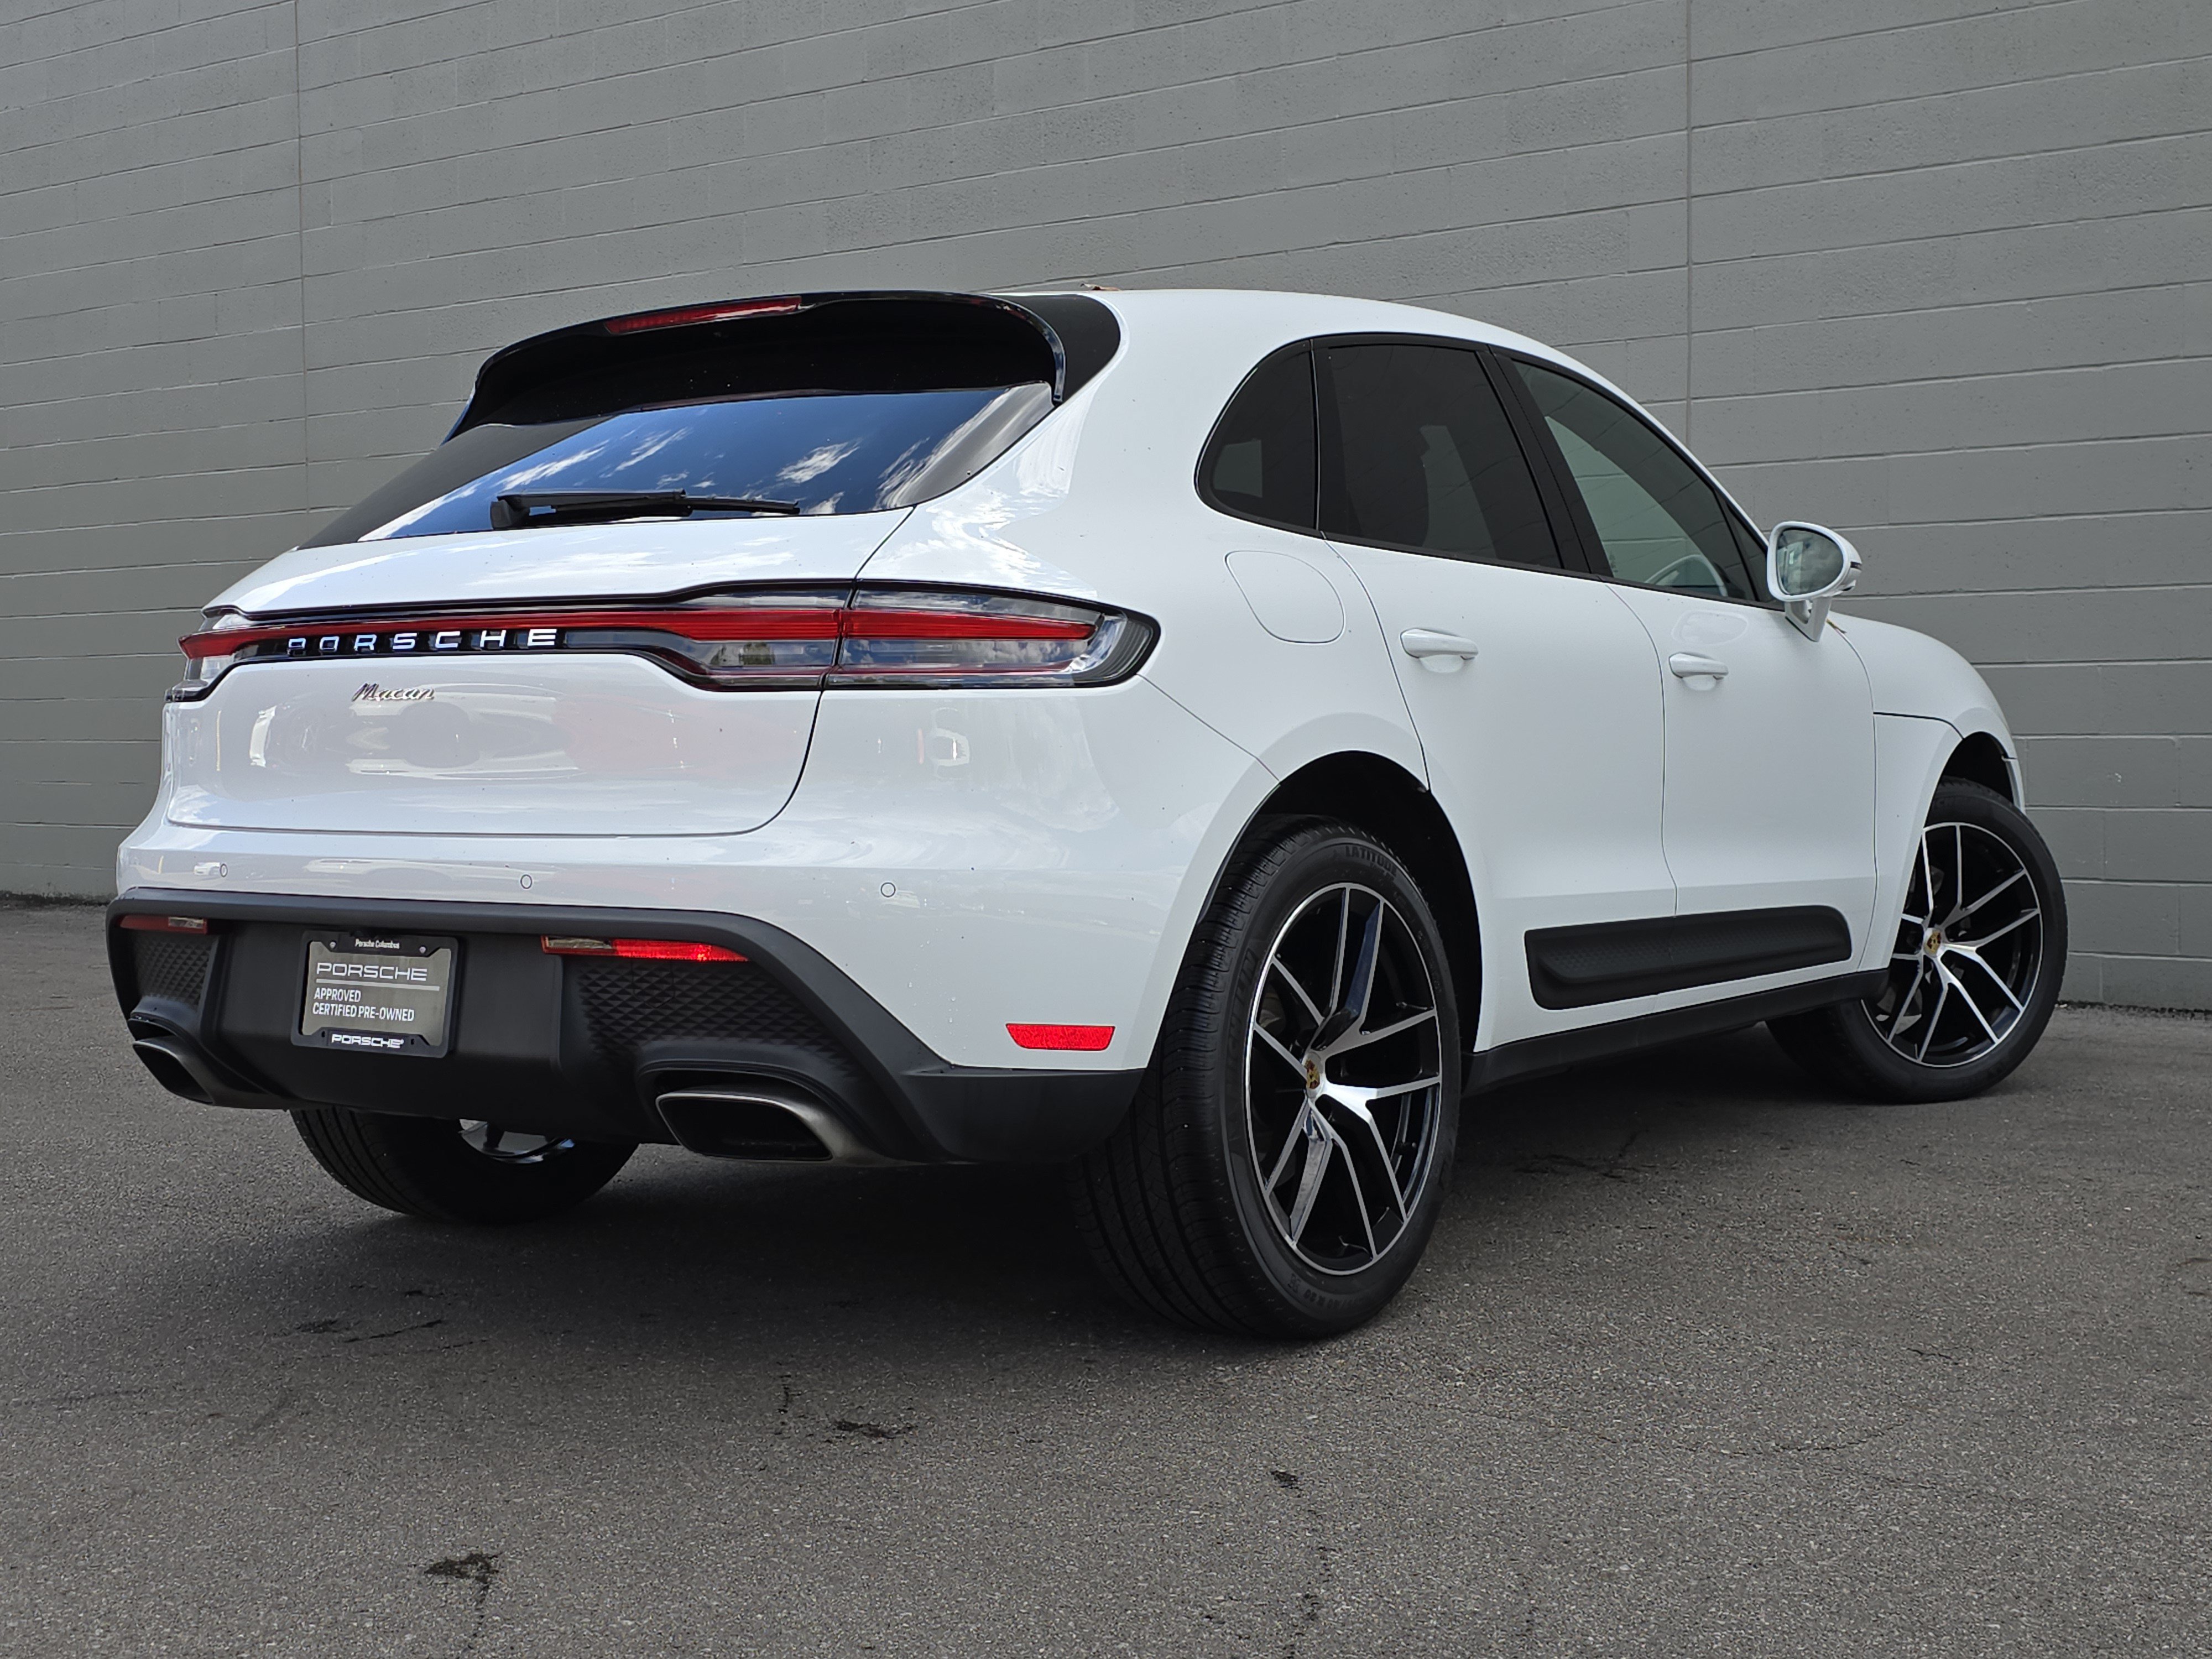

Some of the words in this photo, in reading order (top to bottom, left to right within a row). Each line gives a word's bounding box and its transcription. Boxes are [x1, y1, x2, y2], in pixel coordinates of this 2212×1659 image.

[288, 629, 557, 655] PORSCHE
[352, 682, 435, 702] Macan
[1345, 845, 1397, 877] LATITUDE
[354, 938, 374, 948] Porsche
[316, 962, 427, 982] PORSCHE
[314, 987, 361, 1003] APPROVED
[312, 1001, 356, 1018] CERTIFIED
[357, 1006, 415, 1022] PRE-OWNED
[331, 1033, 403, 1049] PORSCHE
